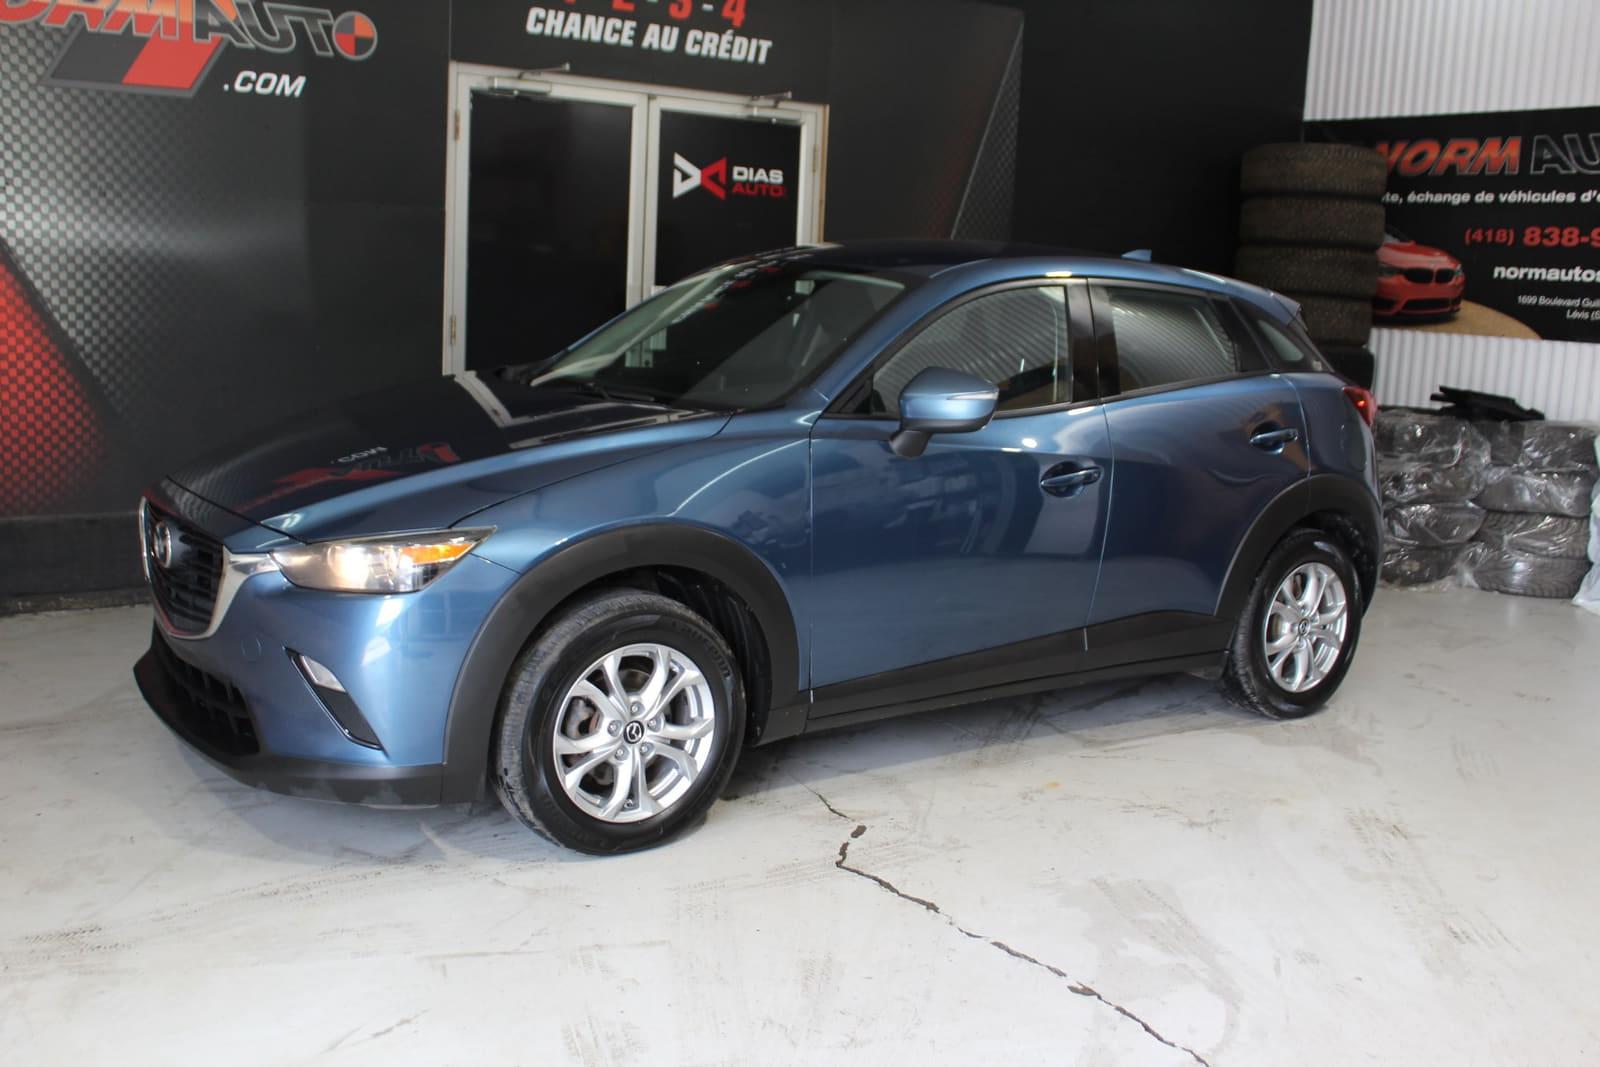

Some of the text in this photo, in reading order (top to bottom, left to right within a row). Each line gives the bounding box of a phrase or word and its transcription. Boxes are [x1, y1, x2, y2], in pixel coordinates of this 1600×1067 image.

[525, 6, 773, 64] CHANCE AU CRÉDIT
[223, 70, 307, 98] .COM
[732, 165, 784, 184] DIAS
[732, 182, 785, 197] AUTO
[1406, 191, 1471, 206] échange
[1474, 190, 1495, 204] de
[1499, 189, 1577, 204] véhicules
[1464, 228, 1515, 247] (418)
[1538, 295, 1581, 307] Boulevard
